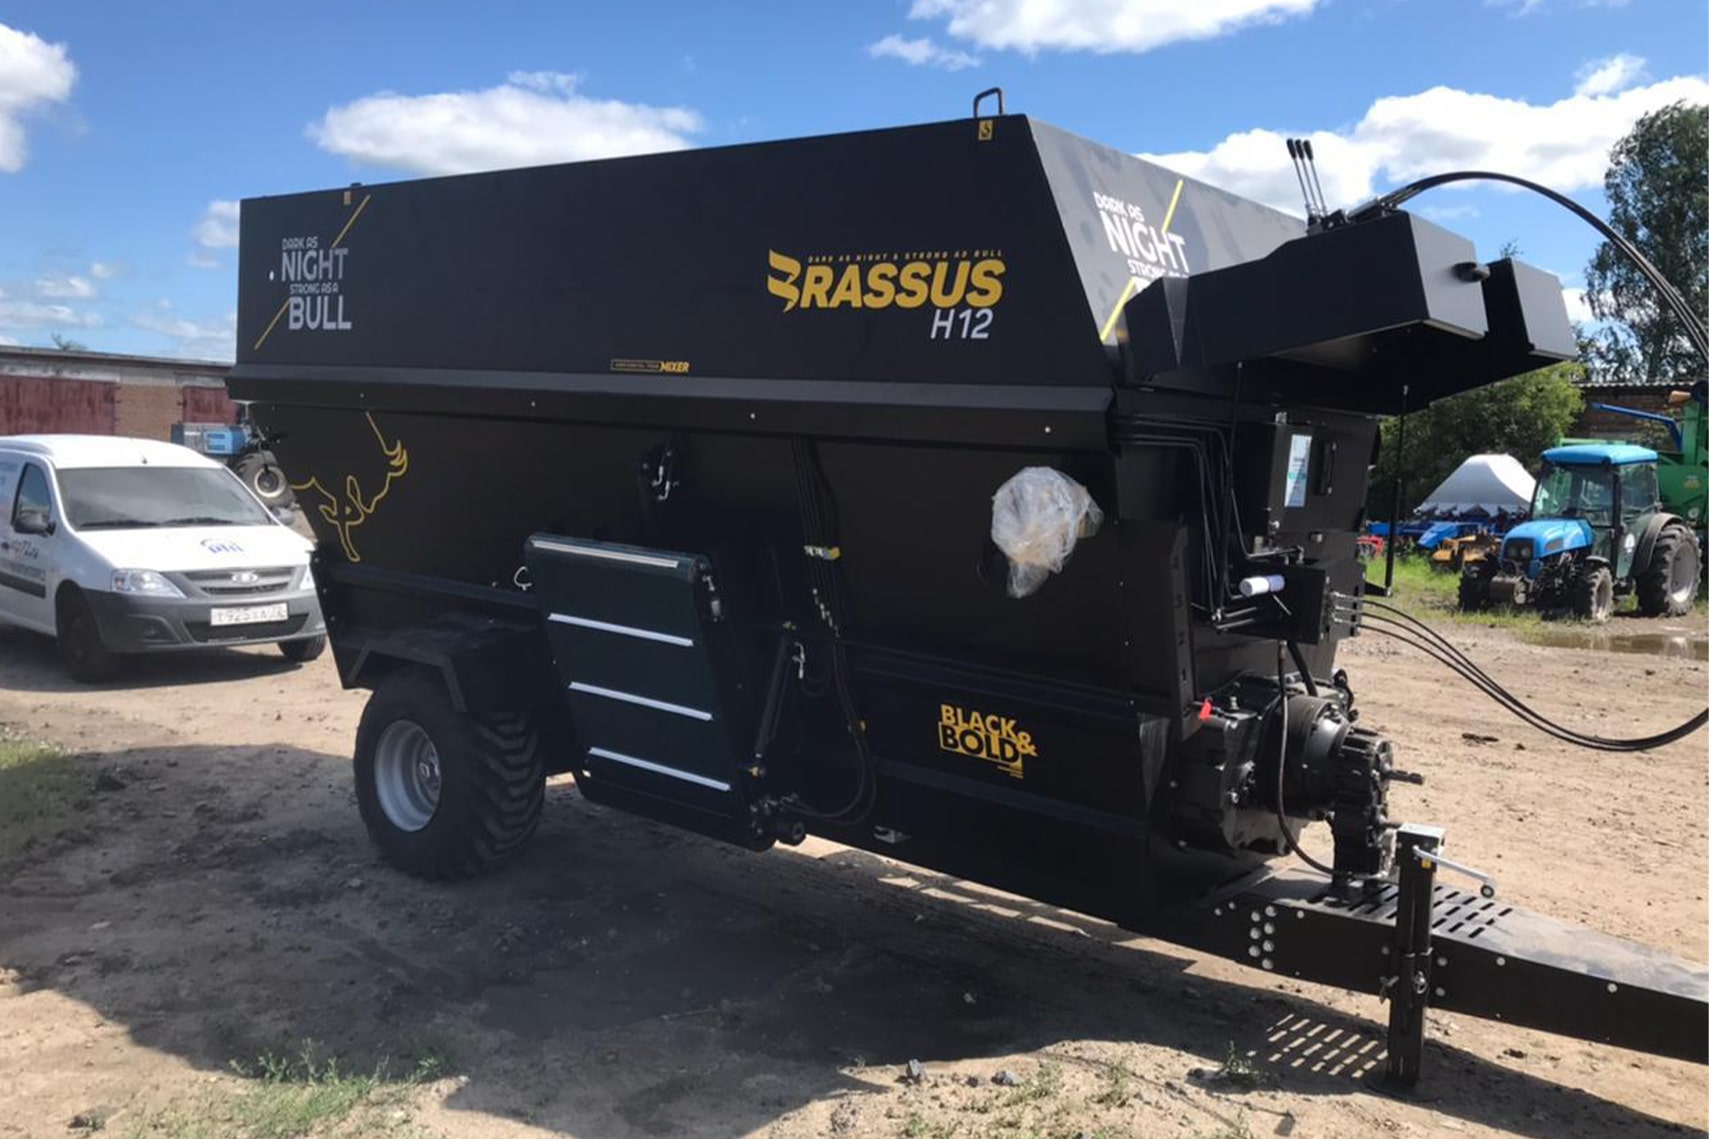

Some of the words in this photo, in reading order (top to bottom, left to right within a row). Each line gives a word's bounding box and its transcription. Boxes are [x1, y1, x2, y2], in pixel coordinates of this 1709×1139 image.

[1093, 191, 1128, 218] DARK
[1127, 202, 1145, 222] AS
[281, 237, 304, 250] DARK
[306, 235, 318, 249] AS
[1099, 210, 1190, 273] NIGHT
[281, 247, 349, 282] NIGHT
[289, 283, 320, 294] STRONG
[288, 295, 352, 330] BULL
[930, 308, 993, 339] H12
[940, 725, 1020, 764] BOLD
